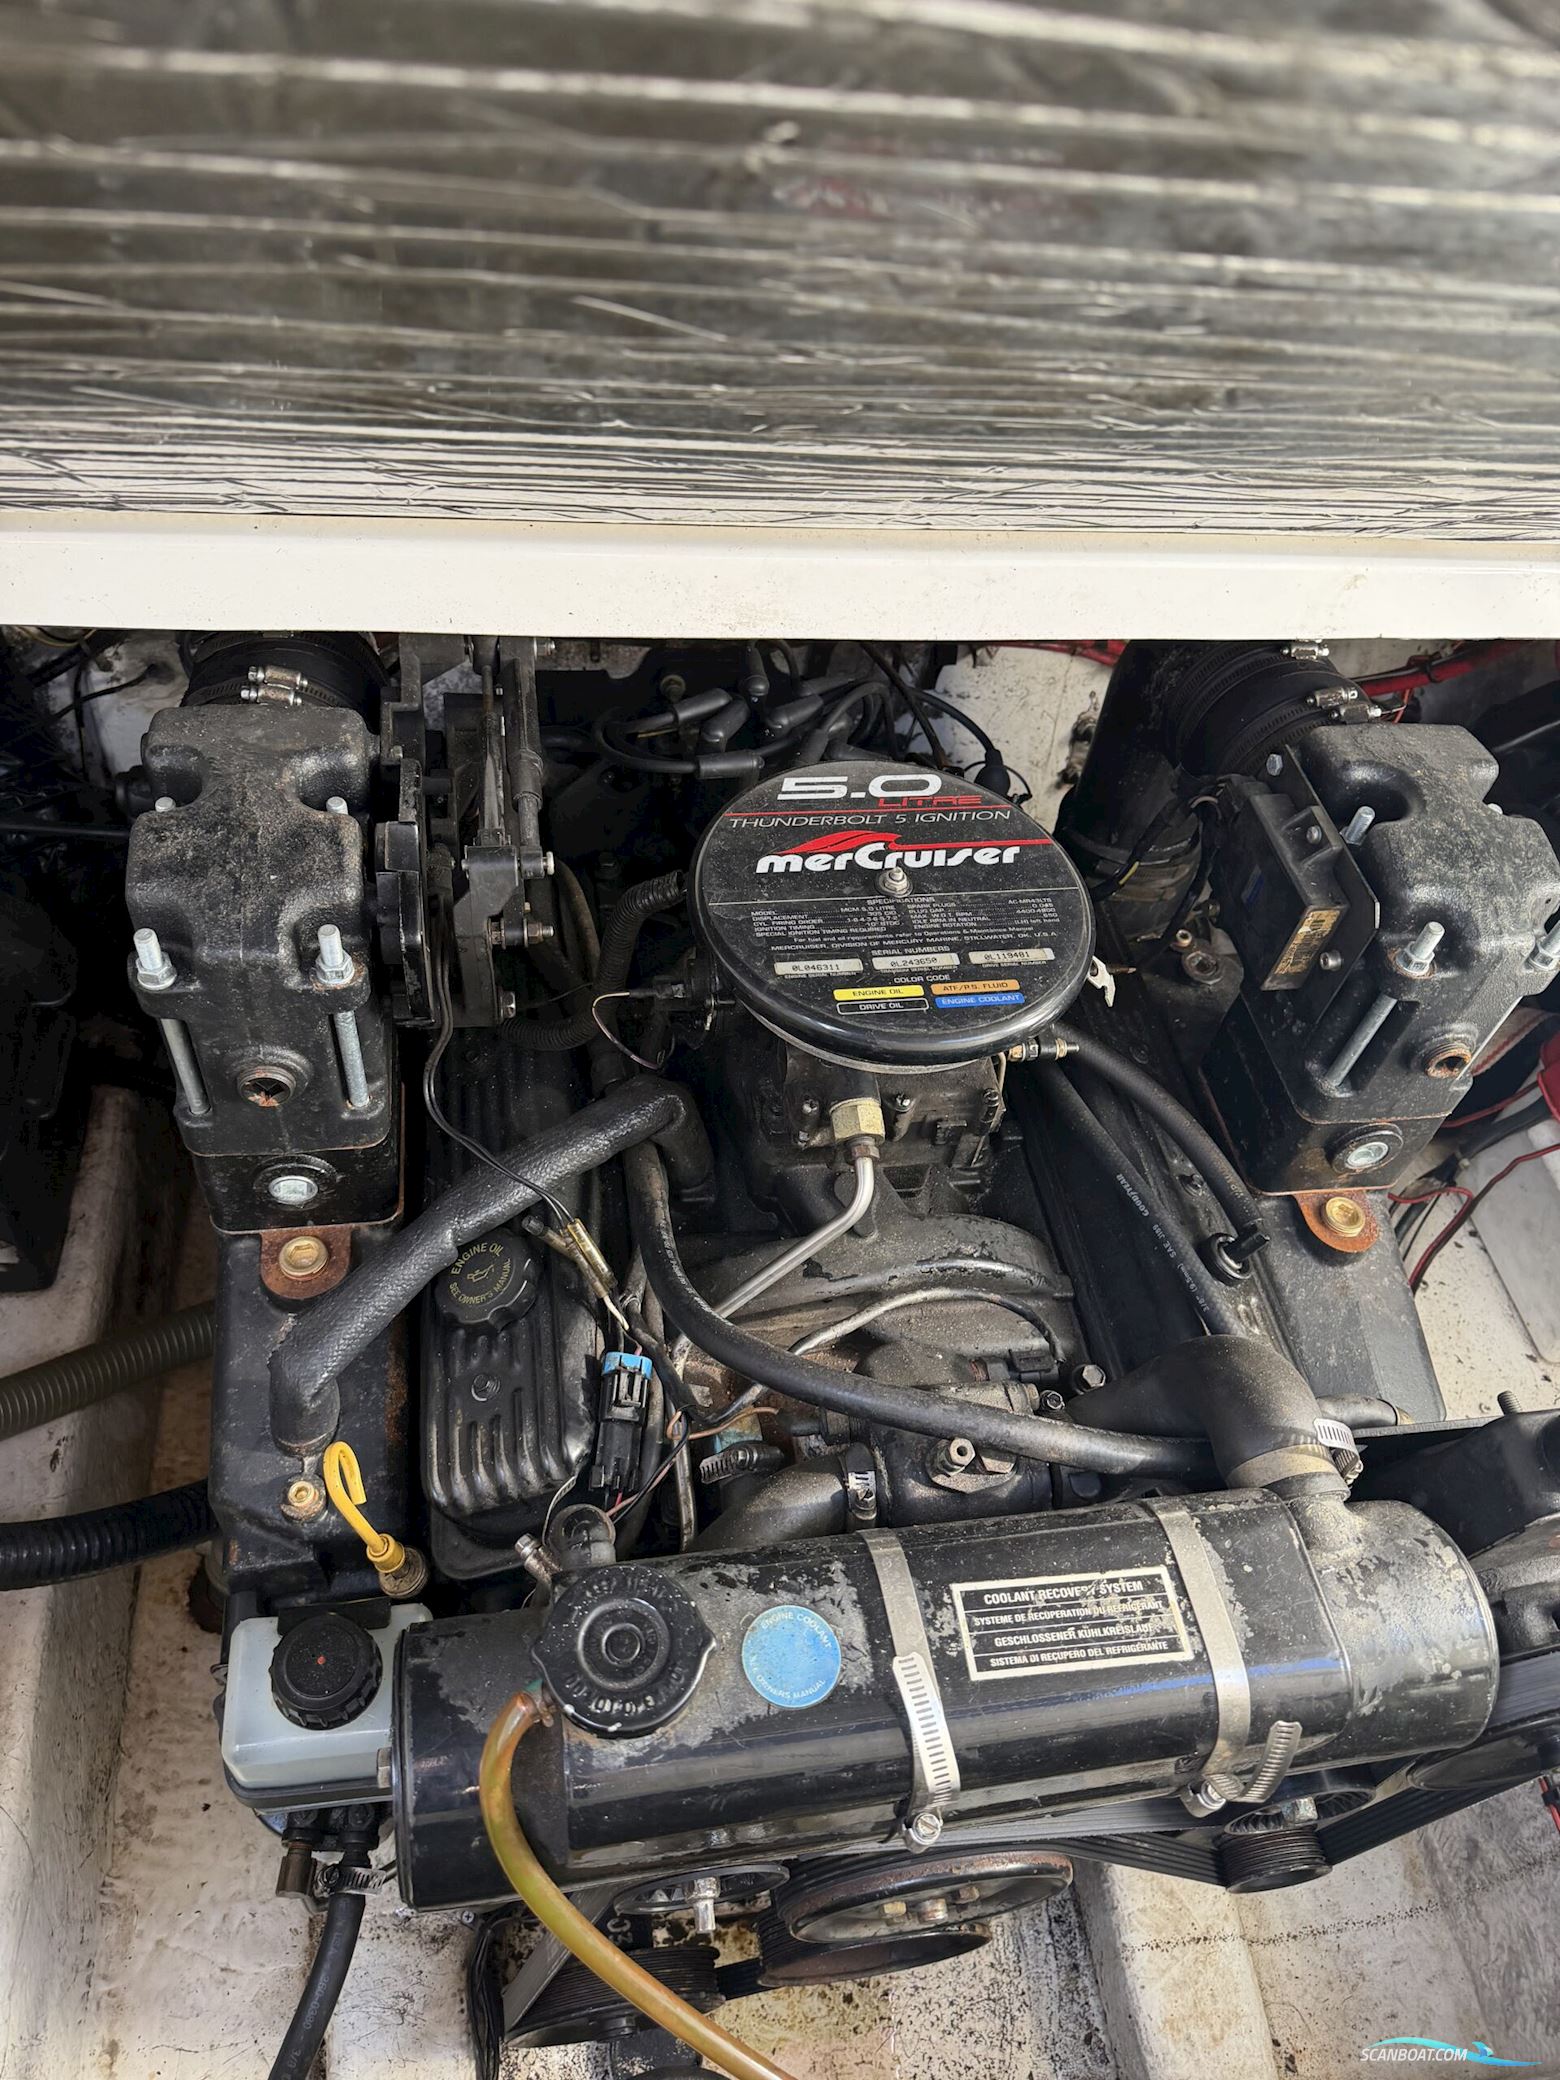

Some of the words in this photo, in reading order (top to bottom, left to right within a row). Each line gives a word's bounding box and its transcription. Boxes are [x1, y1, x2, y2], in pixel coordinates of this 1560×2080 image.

[777, 773, 942, 800] 5.0
[878, 795, 983, 808] LITRE
[729, 813, 887, 829] THUNDERBOLT
[895, 814, 907, 824] 5
[915, 809, 1012, 824] IGNITION
[867, 896, 936, 906] SPECIFICATIONS
[882, 938, 924, 946] MERCURY
[904, 945, 950, 954] NUMBERS
[894, 976, 924, 984] COLOR
[926, 974, 951, 982] CODE
[982, 981, 1008, 990] FLUID
[852, 988, 887, 997] ENGINE
[889, 987, 904, 995] OIL
[941, 997, 976, 1005] ENGINE
[979, 994, 1020, 1003] COOLANT
[858, 1003, 887, 1011] DRIVE
[889, 1002, 904, 1010] OIL
[1116, 1173, 1150, 1217] GOODYEAR
[450, 1242, 488, 1275] ENGINE
[489, 1242, 504, 1257] OIL
[1163, 1240, 1177, 1259] SAE
[450, 1281, 461, 1298] SEE
[493, 1257, 511, 1293] MANUAL
[983, 1590, 1036, 1605] COOLANT
[1099, 1580, 1144, 1596] SYSTEM
[974, 1614, 1013, 1627] SYSTEME
[1014, 1613, 1027, 1624] DE
[1027, 1606, 1092, 1622] RECUPERATION
[761, 1611, 794, 1630] ENGINE
[797, 1613, 833, 1648] COOLANT
[994, 1629, 1077, 1648] GESCHLOSSENER
[989, 1655, 1029, 1668] SISTEMA
[1030, 1654, 1040, 1664] DI
[1041, 1649, 1087, 1663] RECUPERO
[1088, 1647, 1105, 1657] DEL
[793, 1679, 826, 1699] MANUAL
